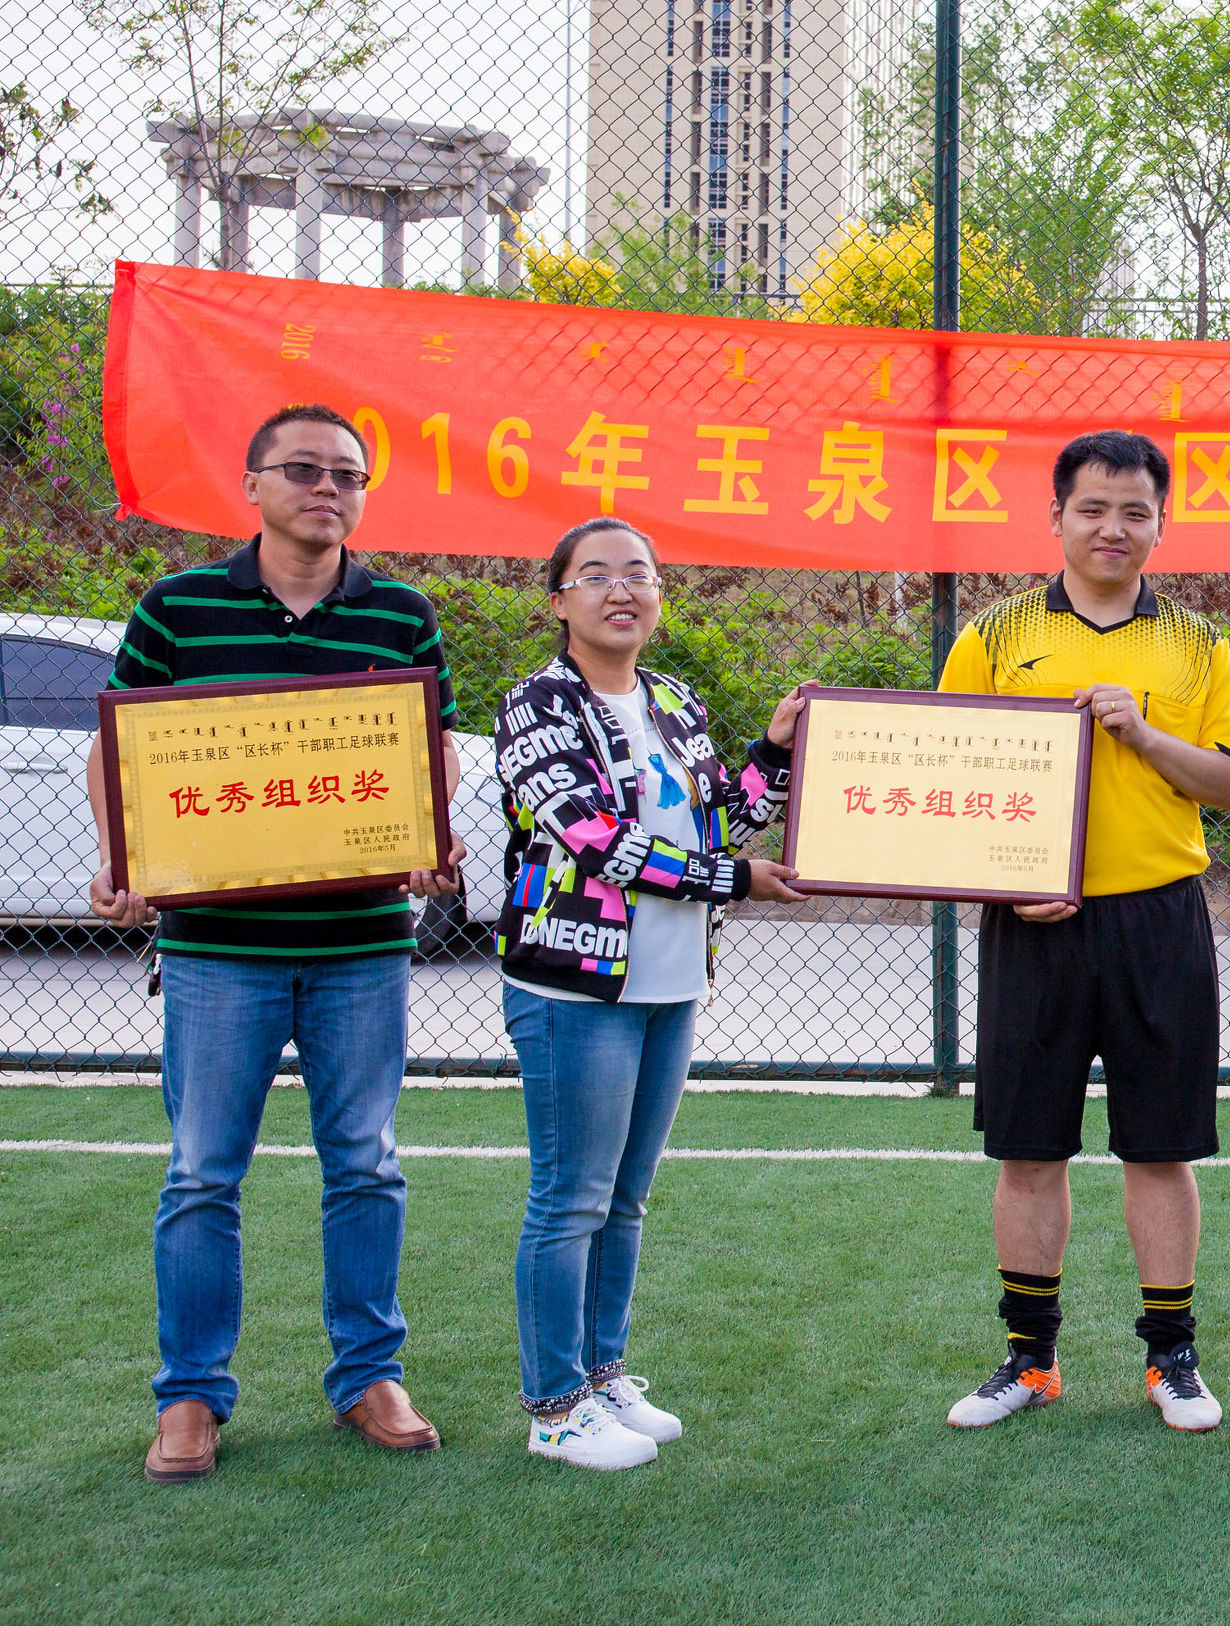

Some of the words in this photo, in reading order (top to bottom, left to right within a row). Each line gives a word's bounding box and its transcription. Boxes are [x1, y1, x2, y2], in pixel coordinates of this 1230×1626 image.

[169, 769, 390, 819] 优秀组织奖
[843, 784, 1037, 823] 优秀组织奖
